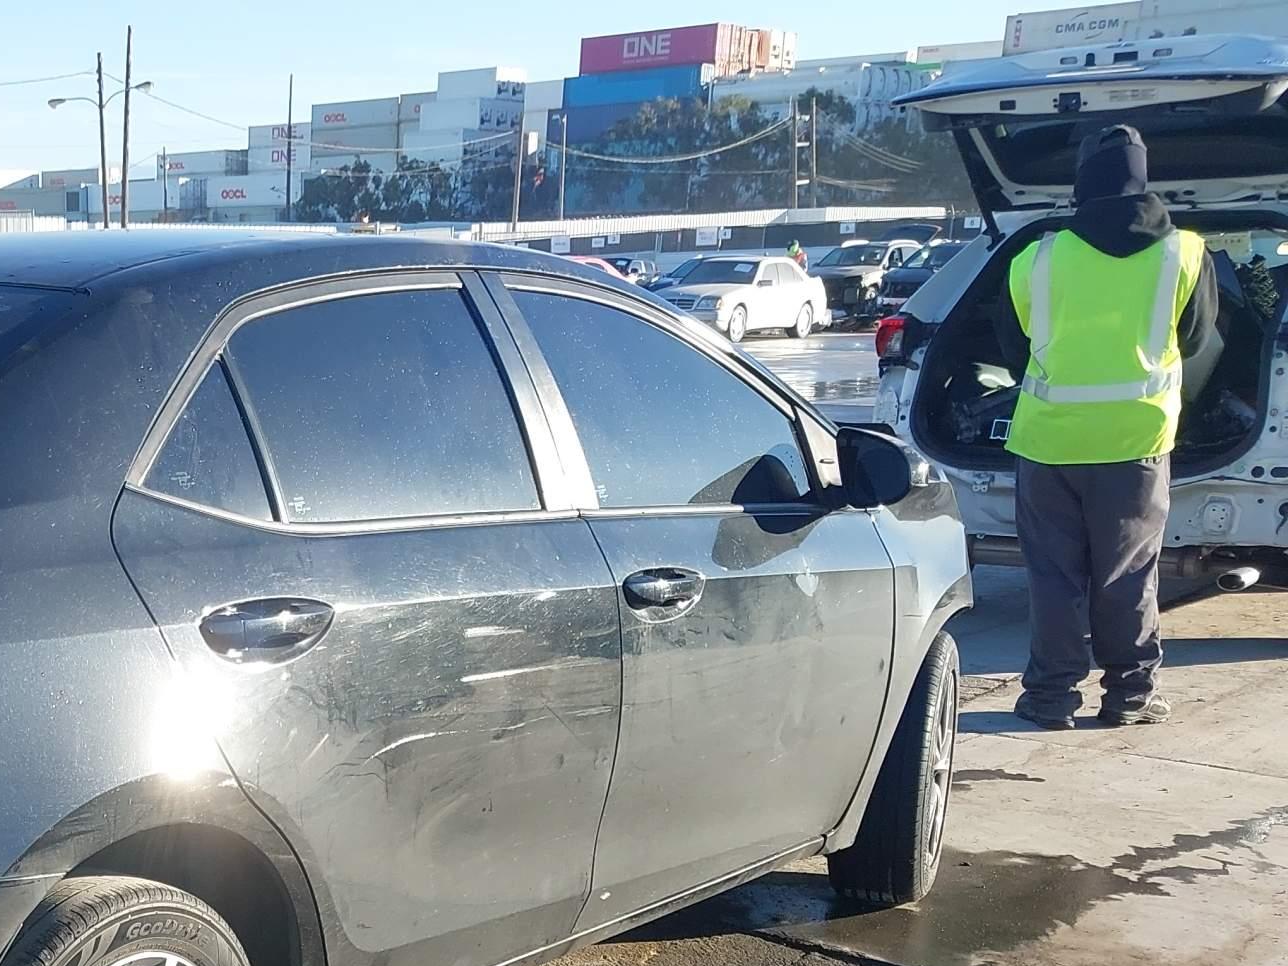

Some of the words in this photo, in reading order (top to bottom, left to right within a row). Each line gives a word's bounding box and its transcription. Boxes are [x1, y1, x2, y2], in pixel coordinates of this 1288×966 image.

[1055, 23, 1085, 34] CMA
[1088, 18, 1120, 31] CGM
[622, 33, 672, 59] ONE
[323, 112, 347, 124] OOCL
[221, 188, 247, 200] OOCL
